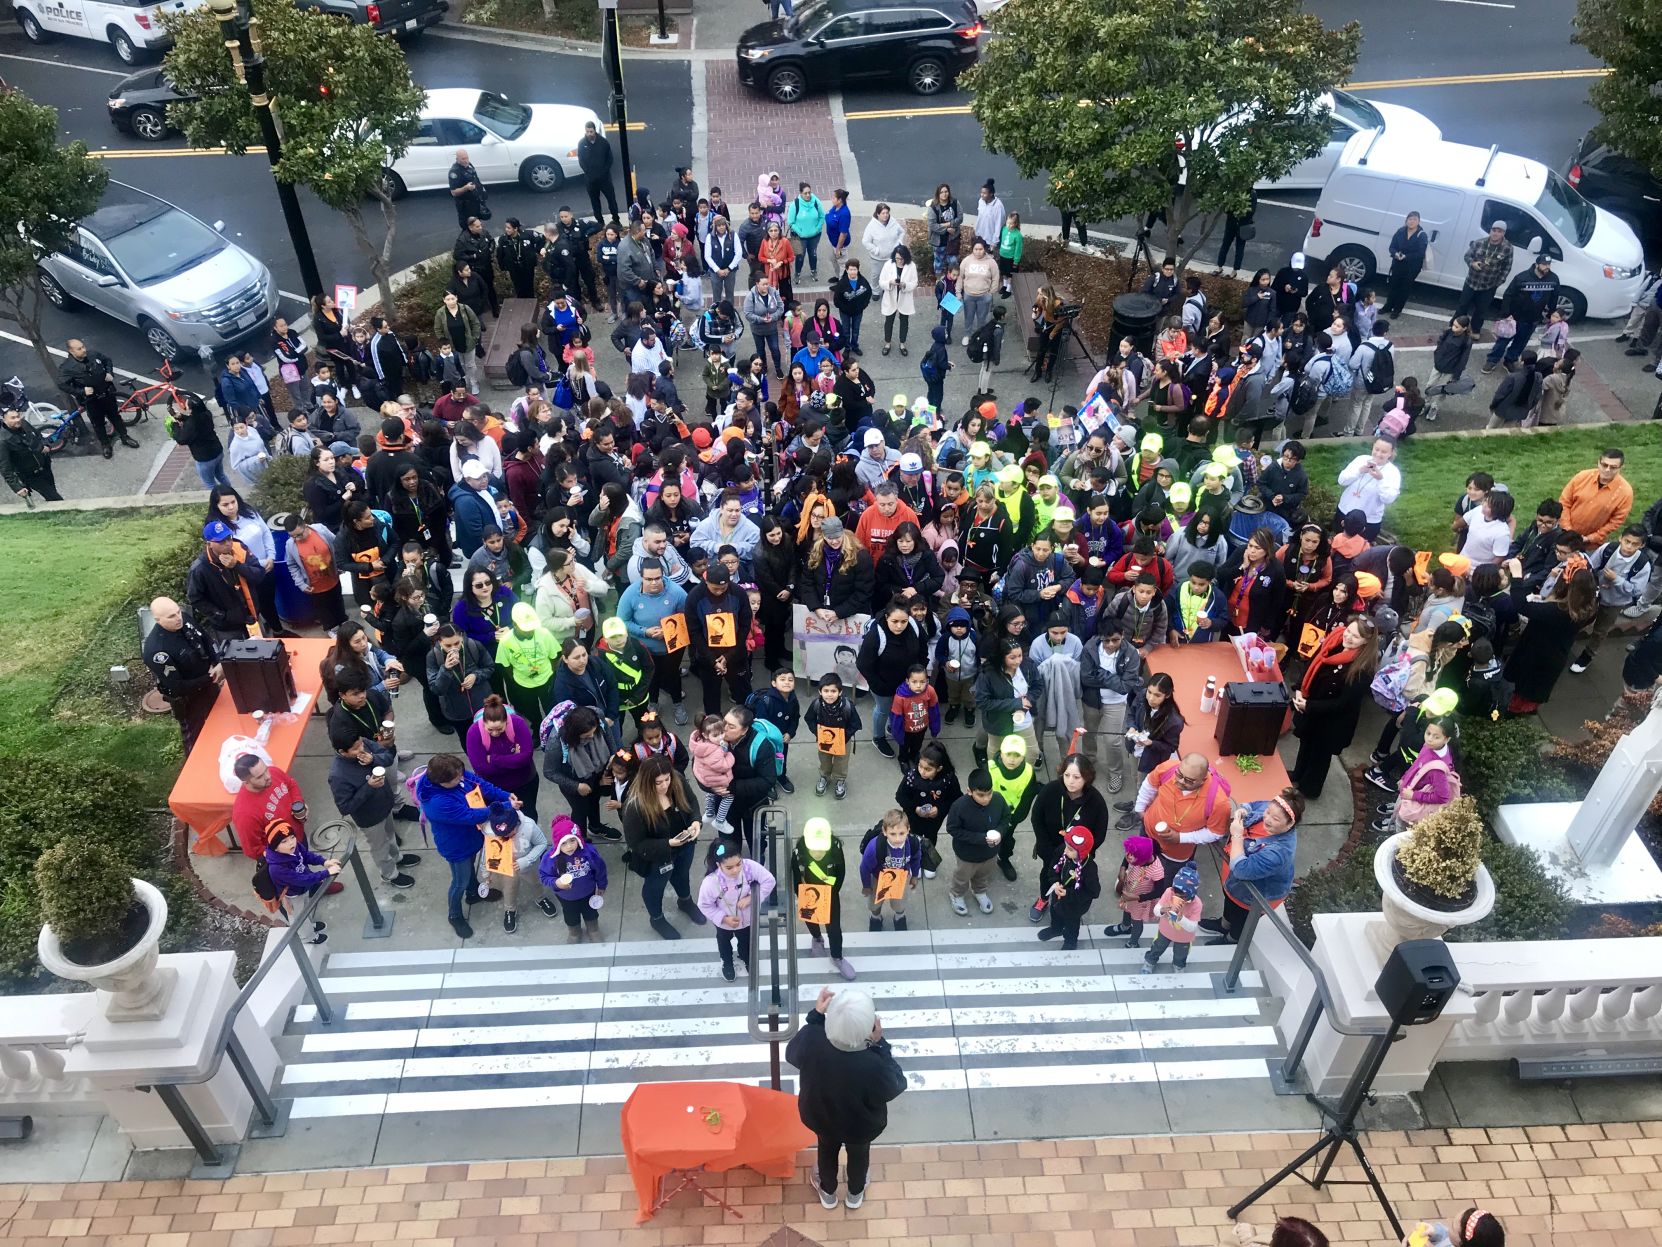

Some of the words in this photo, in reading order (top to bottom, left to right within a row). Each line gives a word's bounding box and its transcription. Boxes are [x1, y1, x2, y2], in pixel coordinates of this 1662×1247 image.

[45, 6, 82, 21] POLICE
[912, 703, 923, 711] BE
[908, 709, 927, 719] TRUE
[913, 718, 924, 726] TO
